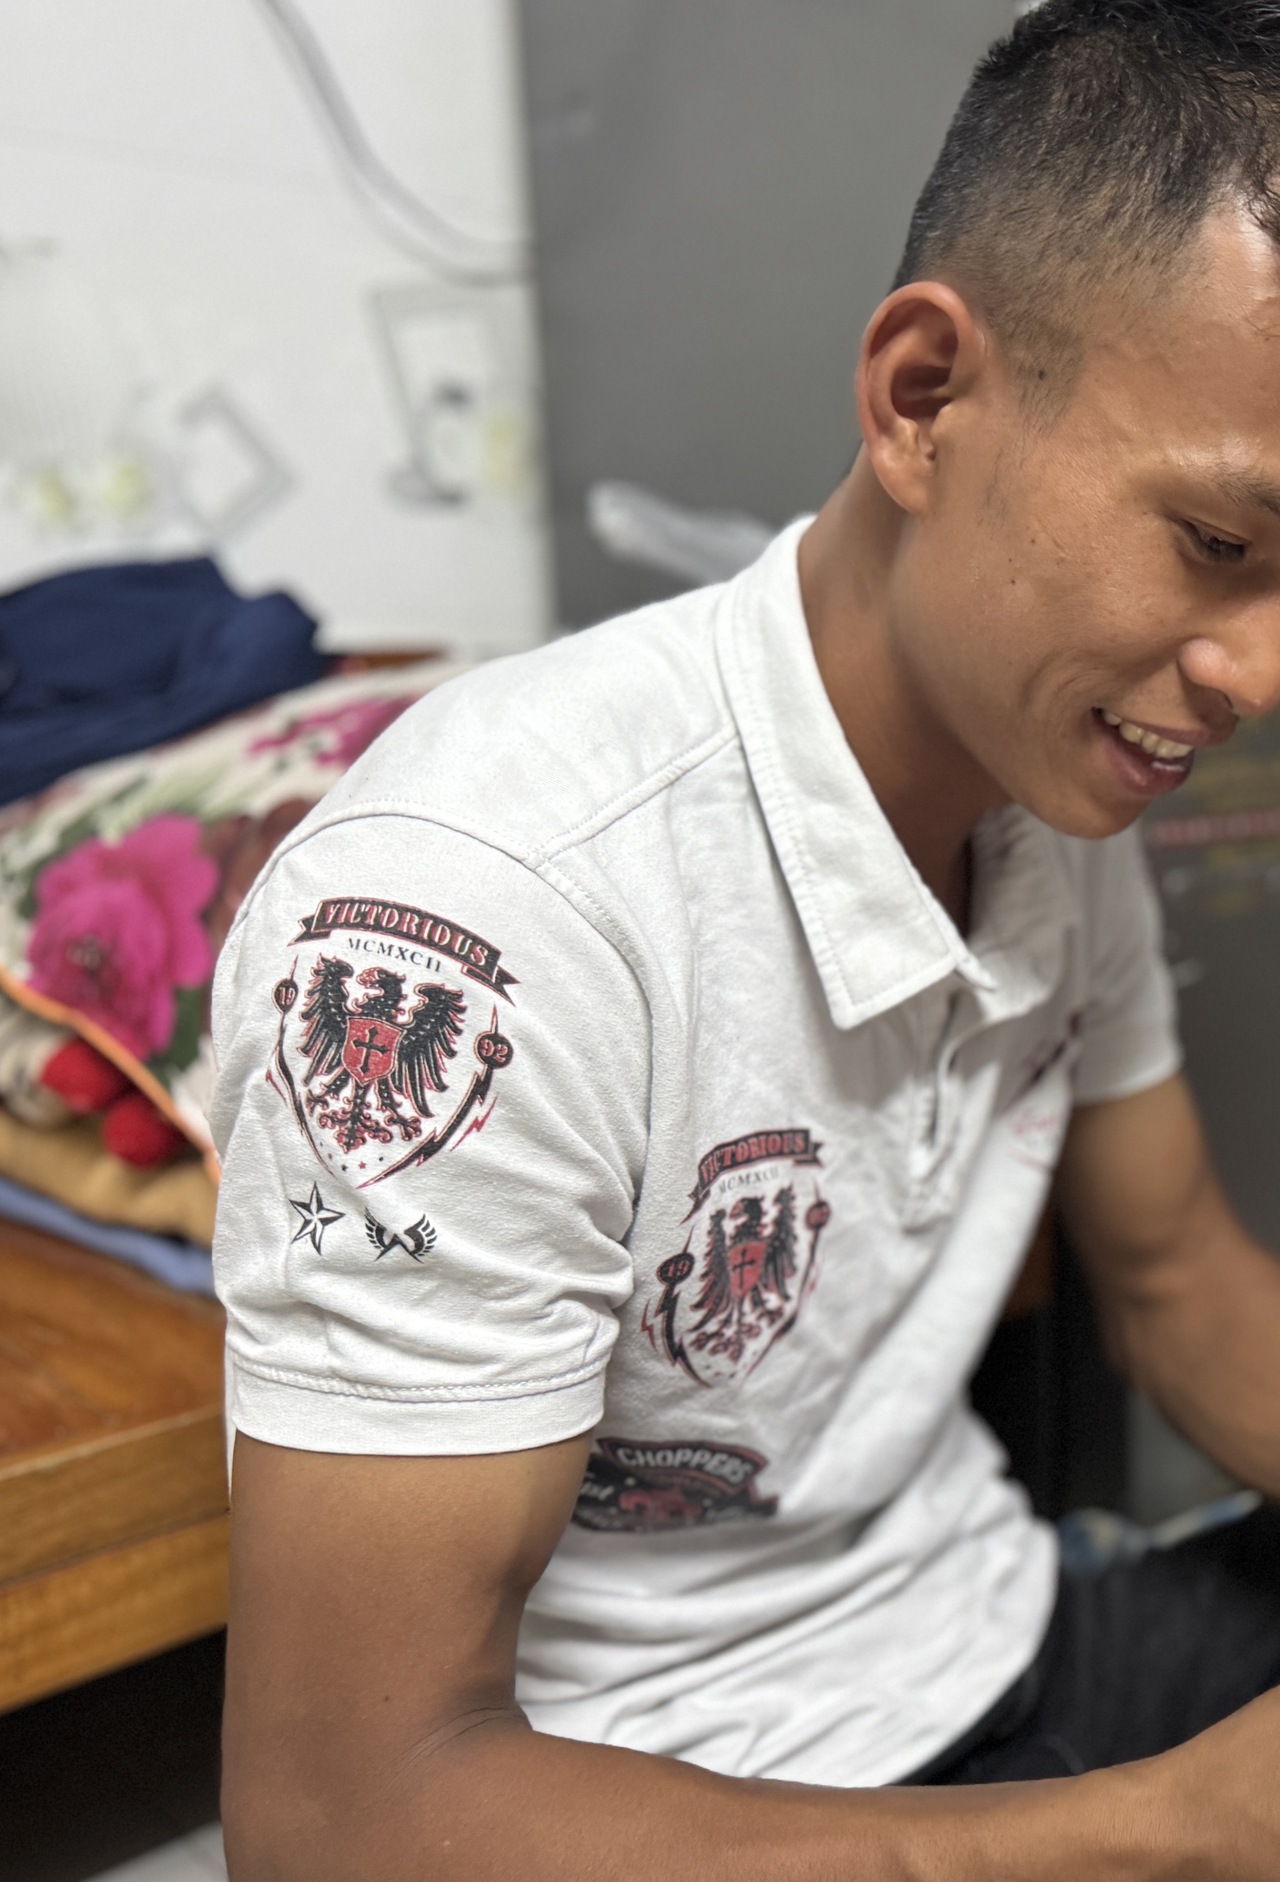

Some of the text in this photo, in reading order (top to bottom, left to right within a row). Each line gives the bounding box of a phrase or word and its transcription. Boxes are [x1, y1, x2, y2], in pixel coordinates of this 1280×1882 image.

[325, 903, 489, 966] VICTORIOUS
[348, 938, 441, 973] MCMXCII
[480, 1039, 509, 1063] 92
[616, 1447, 753, 1485] CHOPPERS
